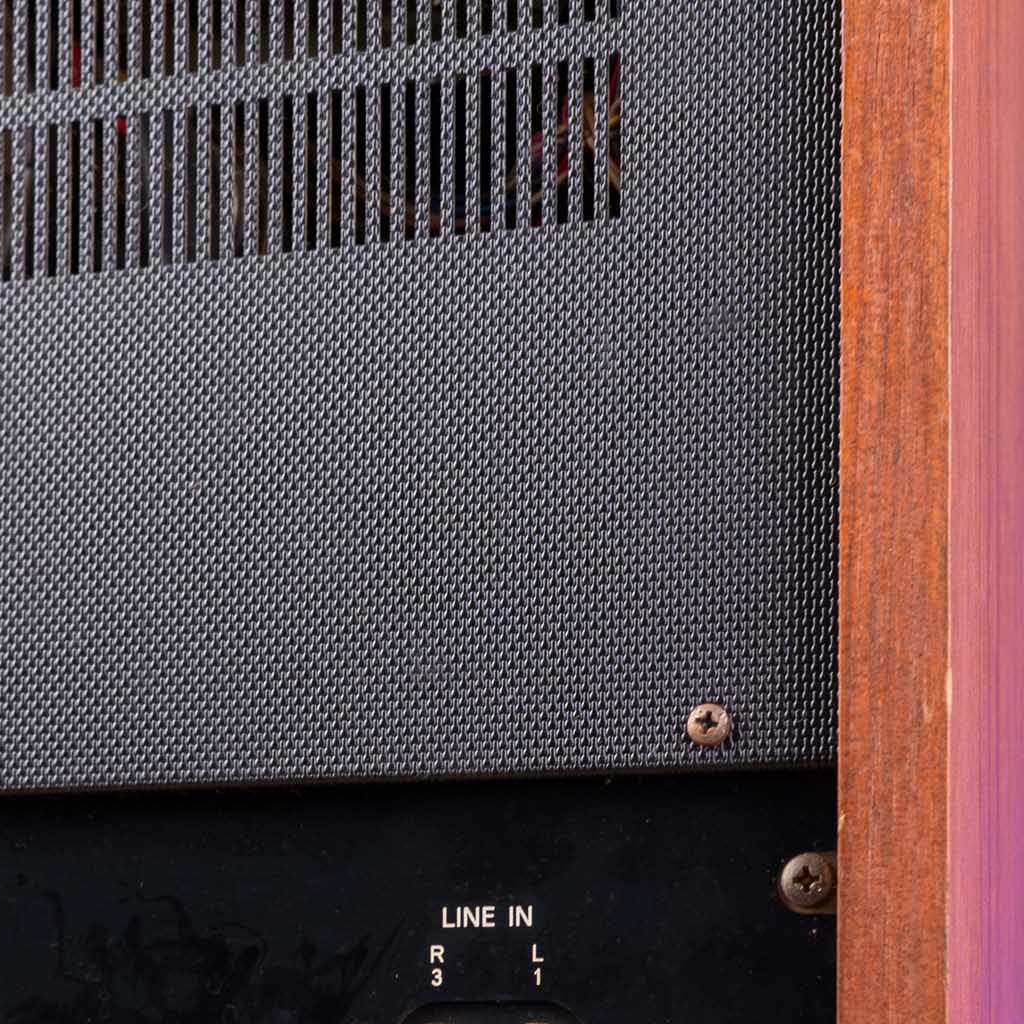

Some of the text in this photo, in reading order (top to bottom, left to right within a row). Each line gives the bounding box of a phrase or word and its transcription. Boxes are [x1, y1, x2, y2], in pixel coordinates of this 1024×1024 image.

[441, 906, 533, 929] LINE IN
[430, 945, 544, 963] R L
[431, 968, 542, 987] 3 1
